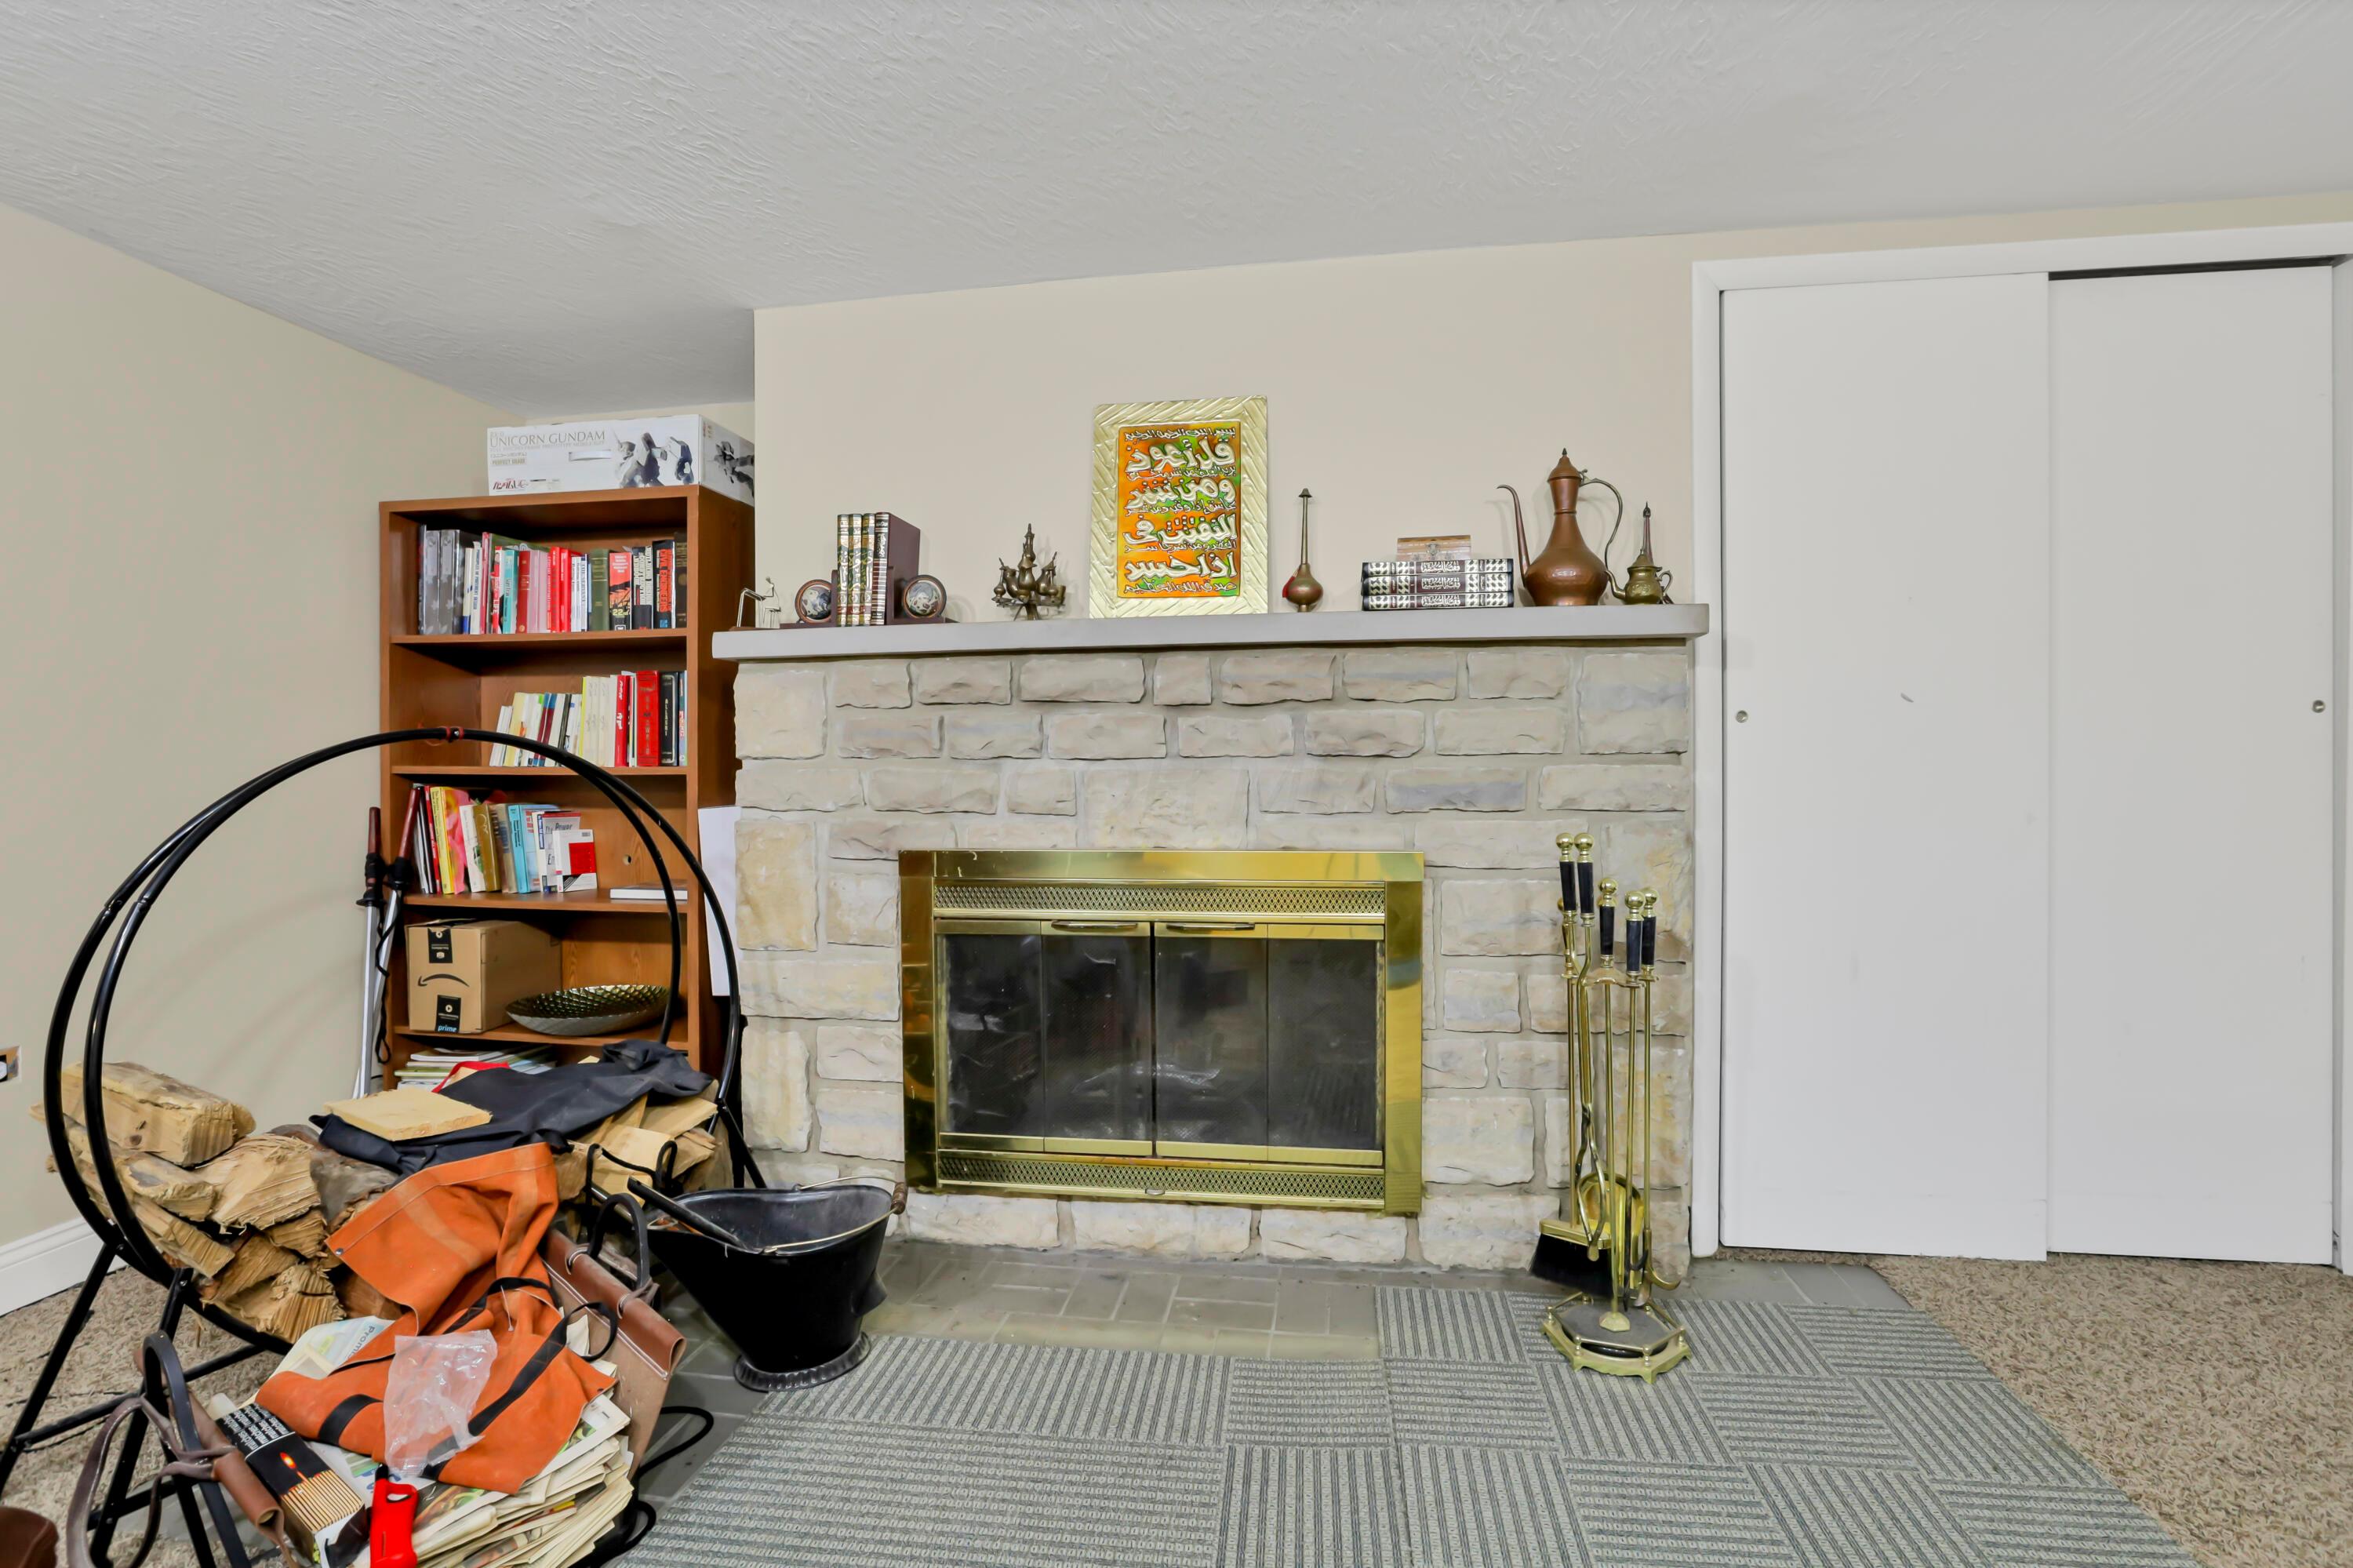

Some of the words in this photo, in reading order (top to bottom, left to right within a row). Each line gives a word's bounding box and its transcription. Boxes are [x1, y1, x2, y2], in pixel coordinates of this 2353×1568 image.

[490, 433, 545, 448] UNICORN
[548, 431, 606, 445] GUNDAM
[660, 549, 668, 568] CIVIL
[660, 569, 669, 613] ENGINEERS
[555, 822, 573, 831] Power
[438, 1024, 457, 1033] prime
